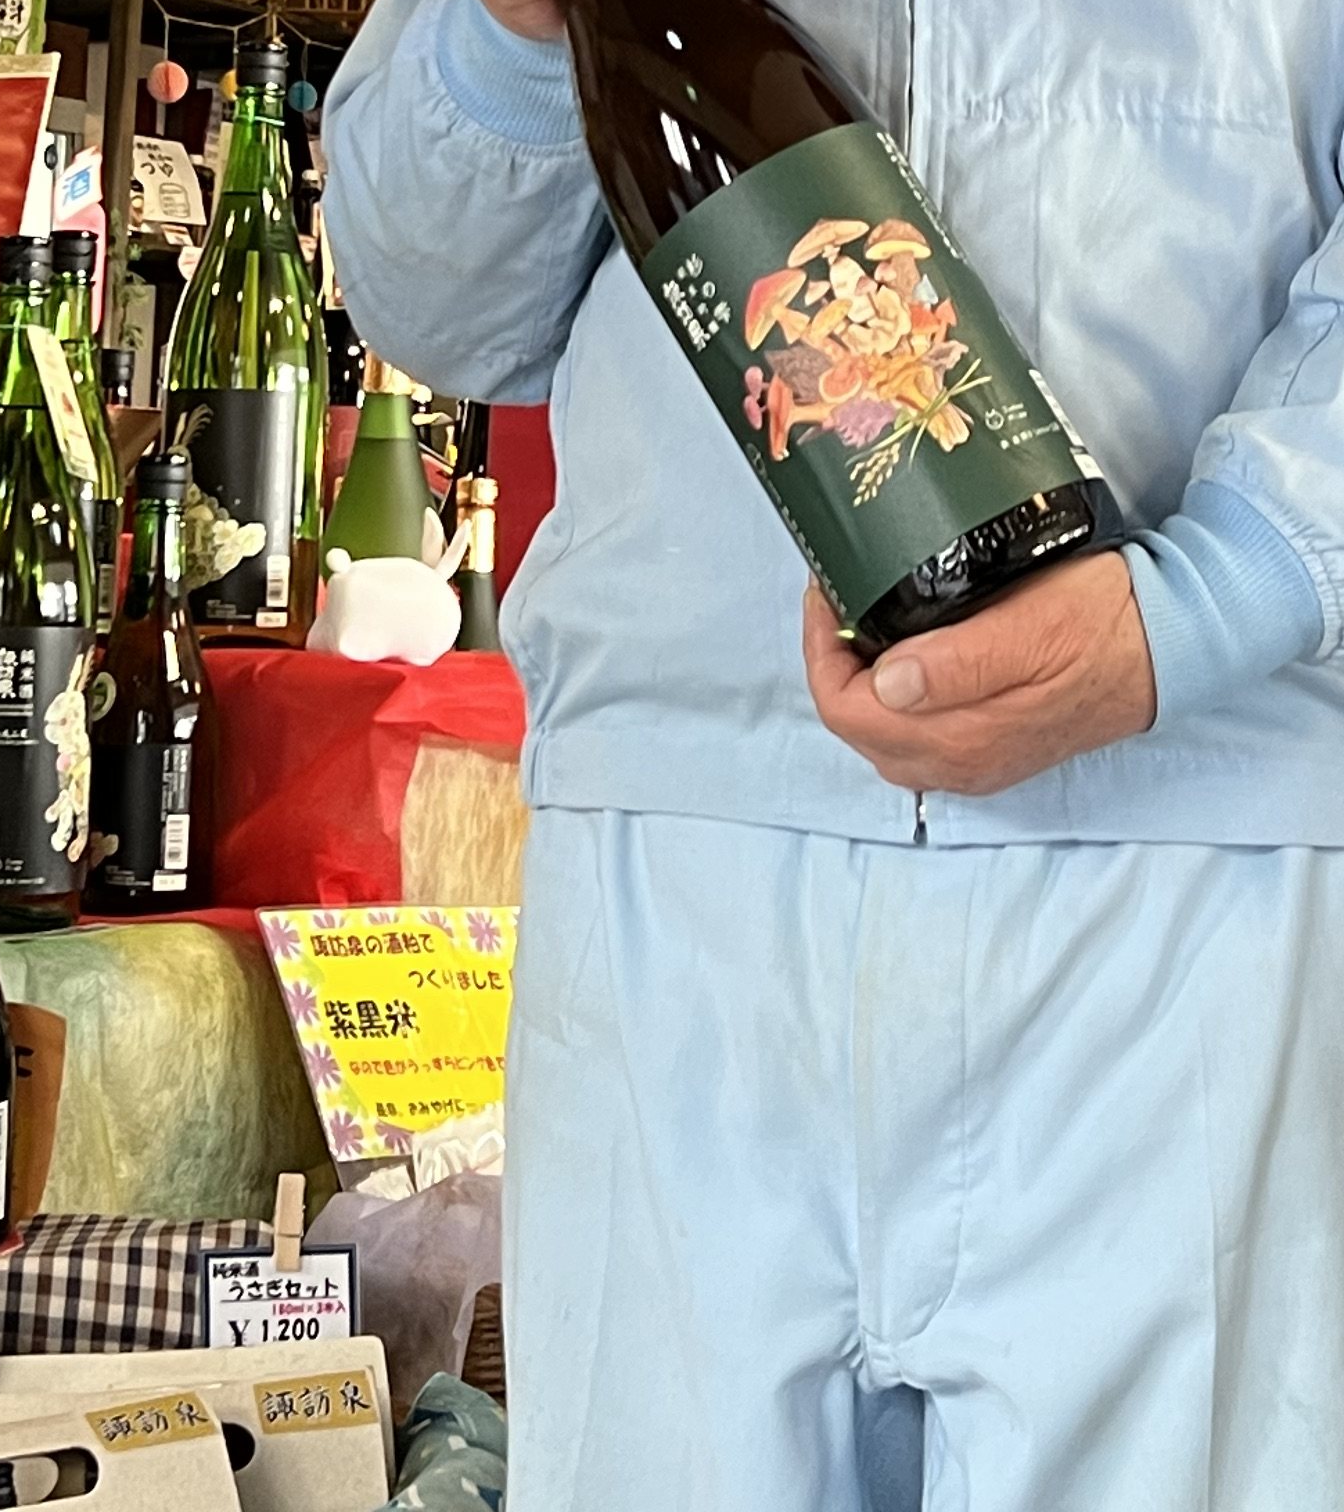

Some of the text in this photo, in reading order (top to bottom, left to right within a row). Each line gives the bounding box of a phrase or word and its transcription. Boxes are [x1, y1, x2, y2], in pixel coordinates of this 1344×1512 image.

[228, 1277, 339, 1302] うさぎセット
[99, 1400, 209, 1442] 諏訪泉
[260, 1380, 371, 1424] 諏訪泉
